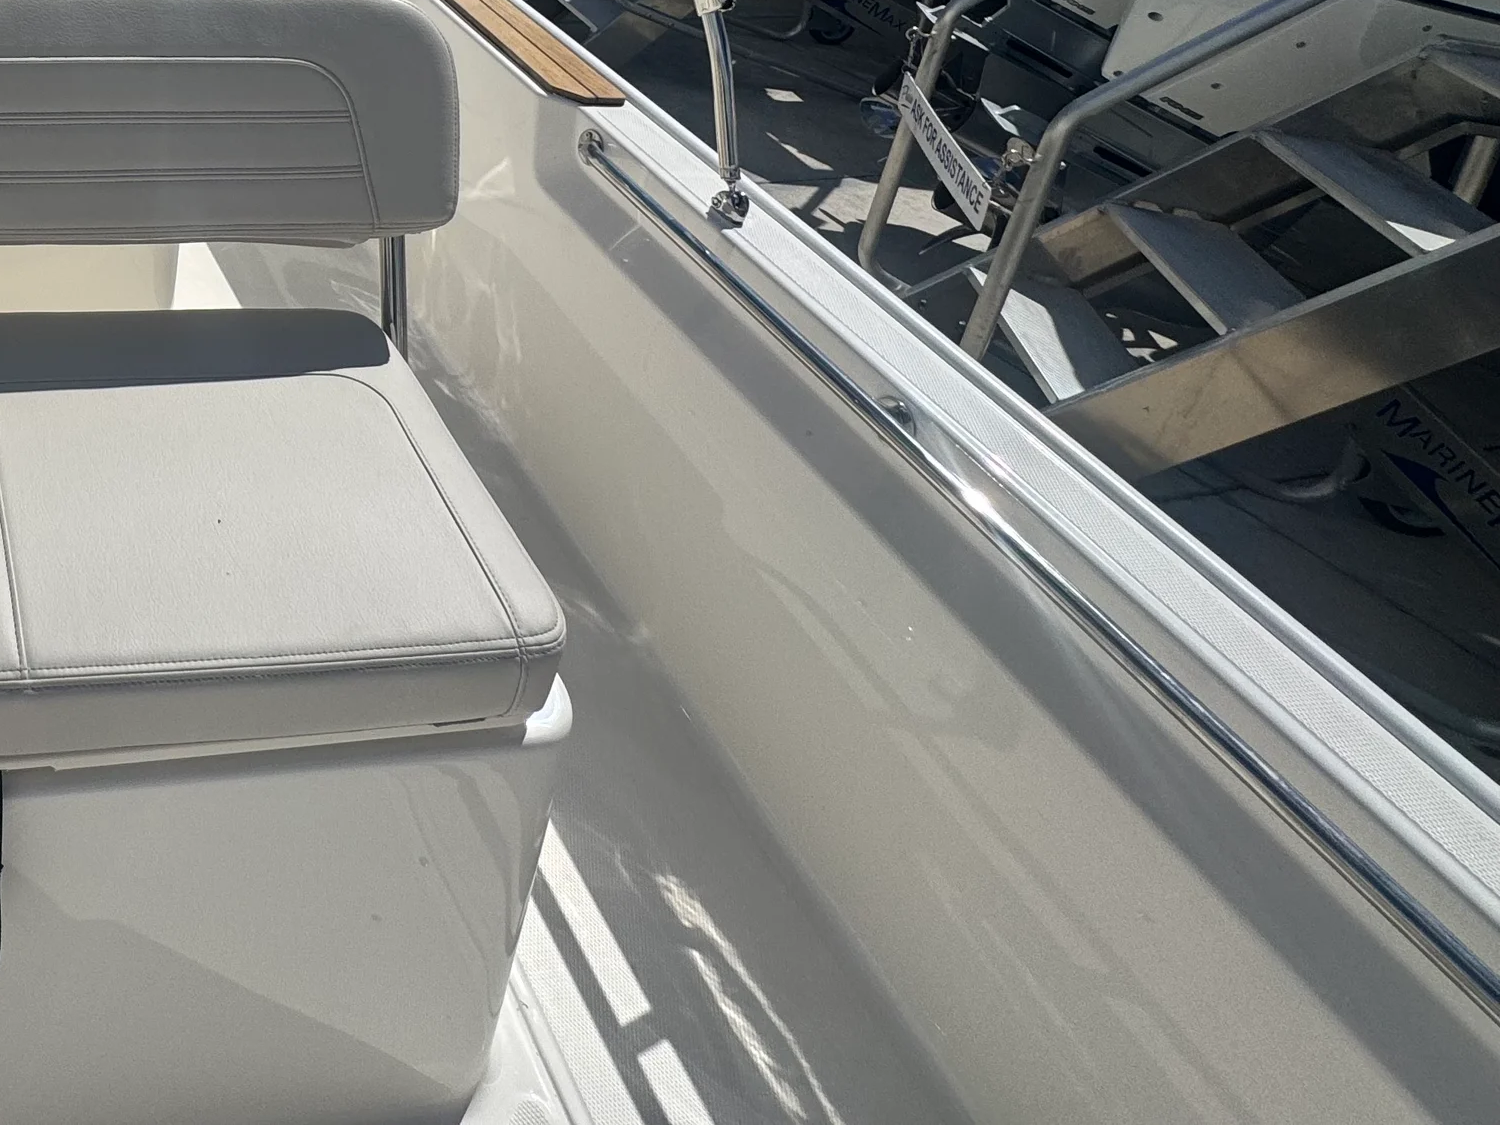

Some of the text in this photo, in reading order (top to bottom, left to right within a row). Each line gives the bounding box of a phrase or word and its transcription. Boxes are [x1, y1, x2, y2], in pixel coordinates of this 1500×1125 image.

[910, 98, 984, 214] ASK FOR ASSISTANCE
[1376, 398, 1500, 527] MARINE
